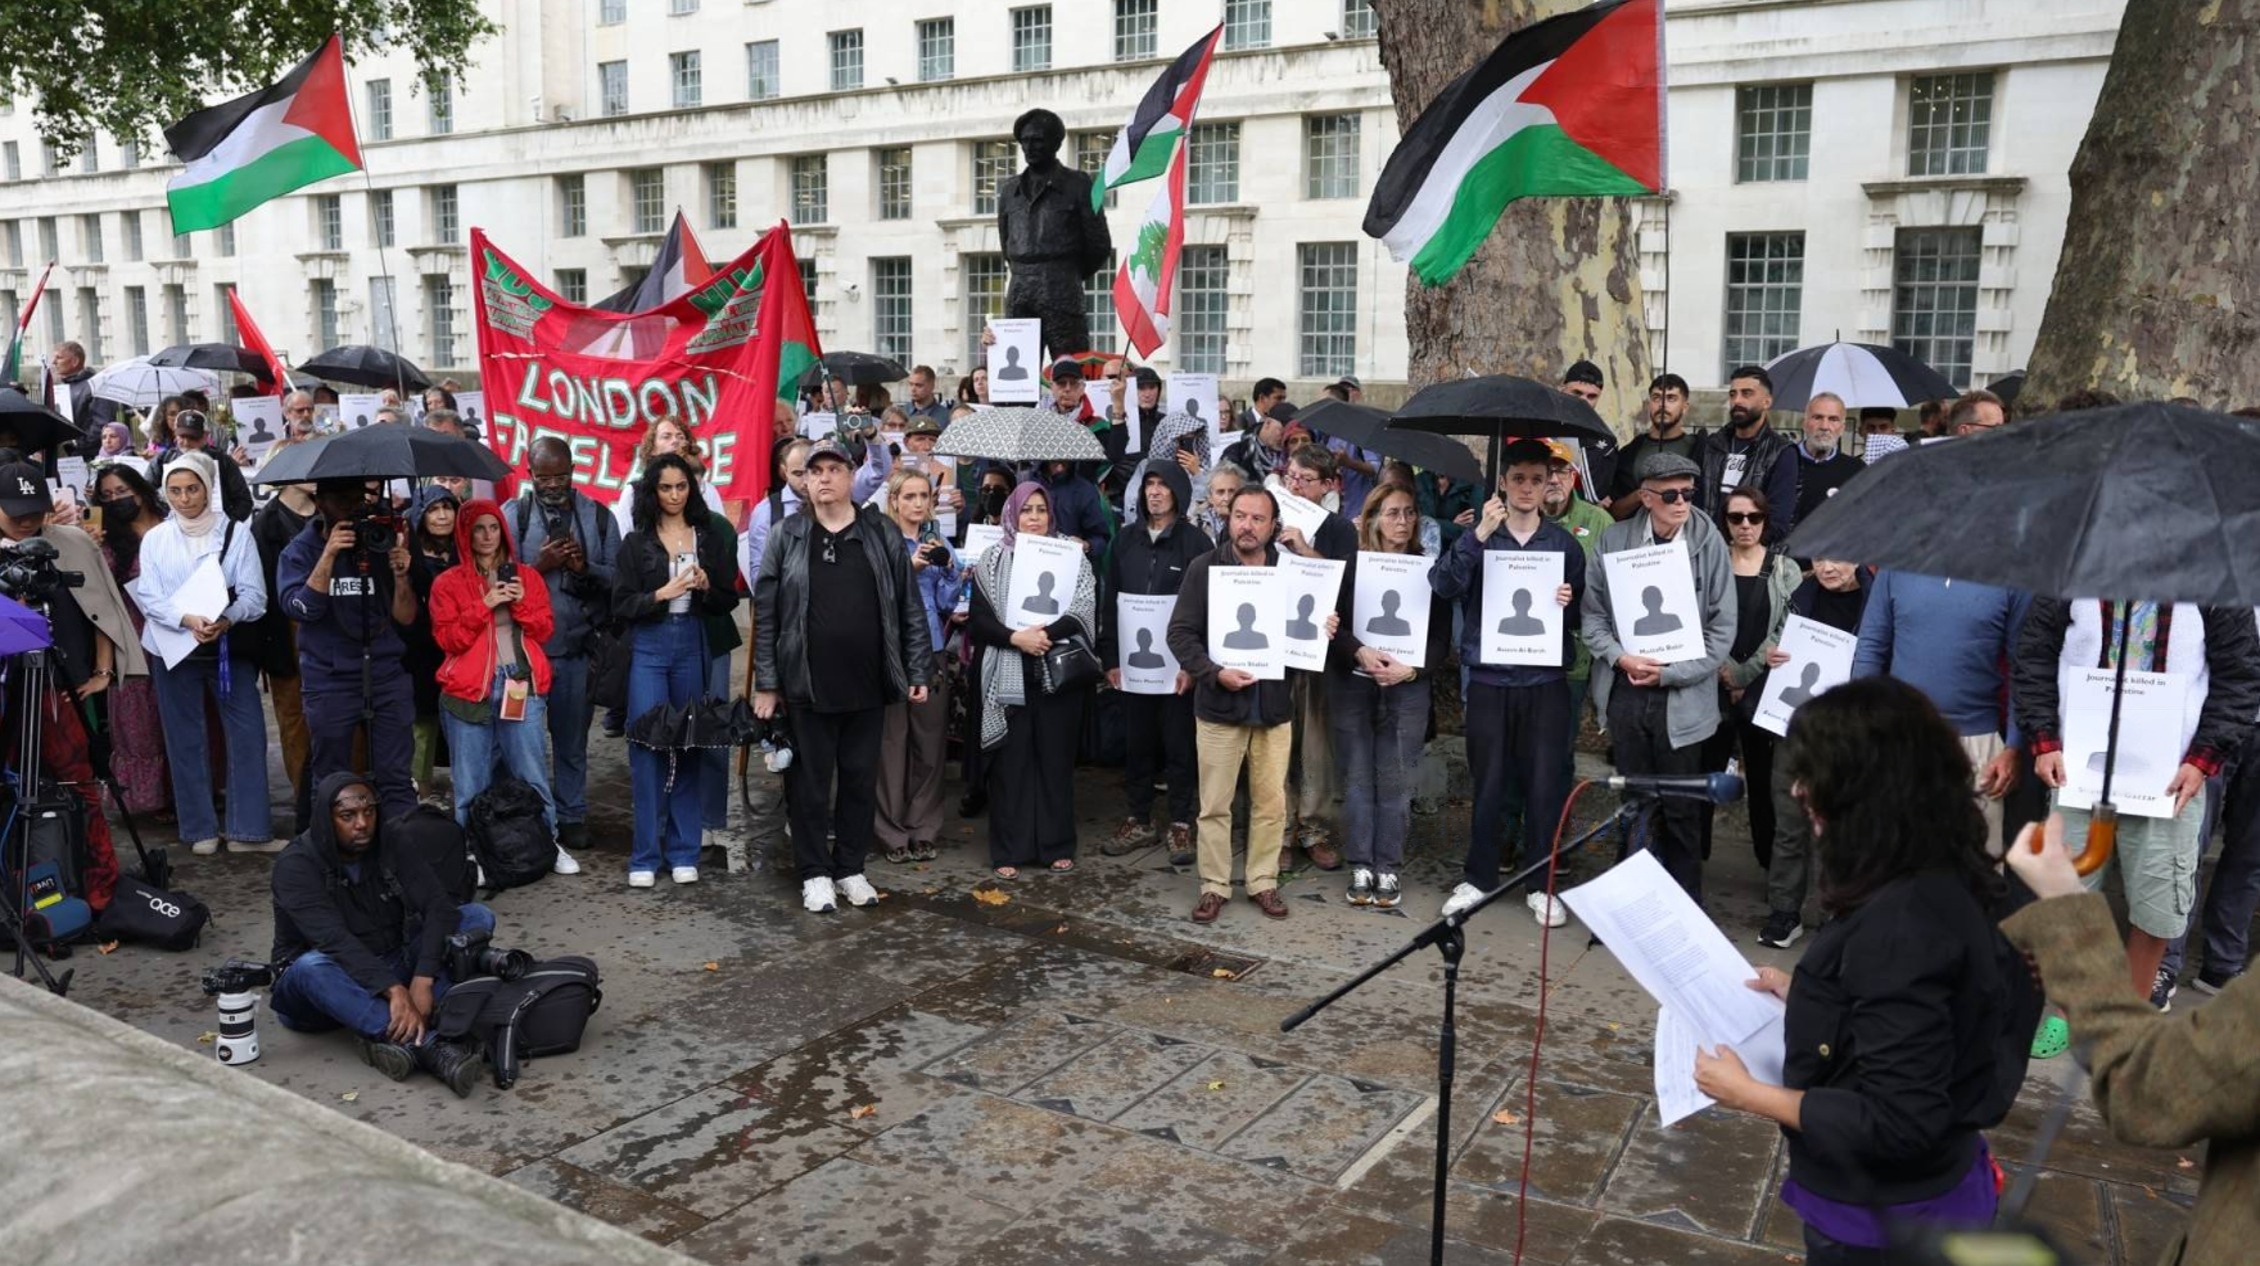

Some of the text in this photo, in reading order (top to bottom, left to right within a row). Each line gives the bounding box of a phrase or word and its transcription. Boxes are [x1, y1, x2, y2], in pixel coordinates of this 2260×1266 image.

[518, 361, 720, 428] LONDON
[493, 411, 737, 490] FRELCE
[17, 477, 36, 495] LA
[333, 578, 370, 594] PRES
[2086, 673, 2129, 684] Journat
[2130, 677, 2155, 685] killed
[2105, 685, 2144, 695] Pastine
